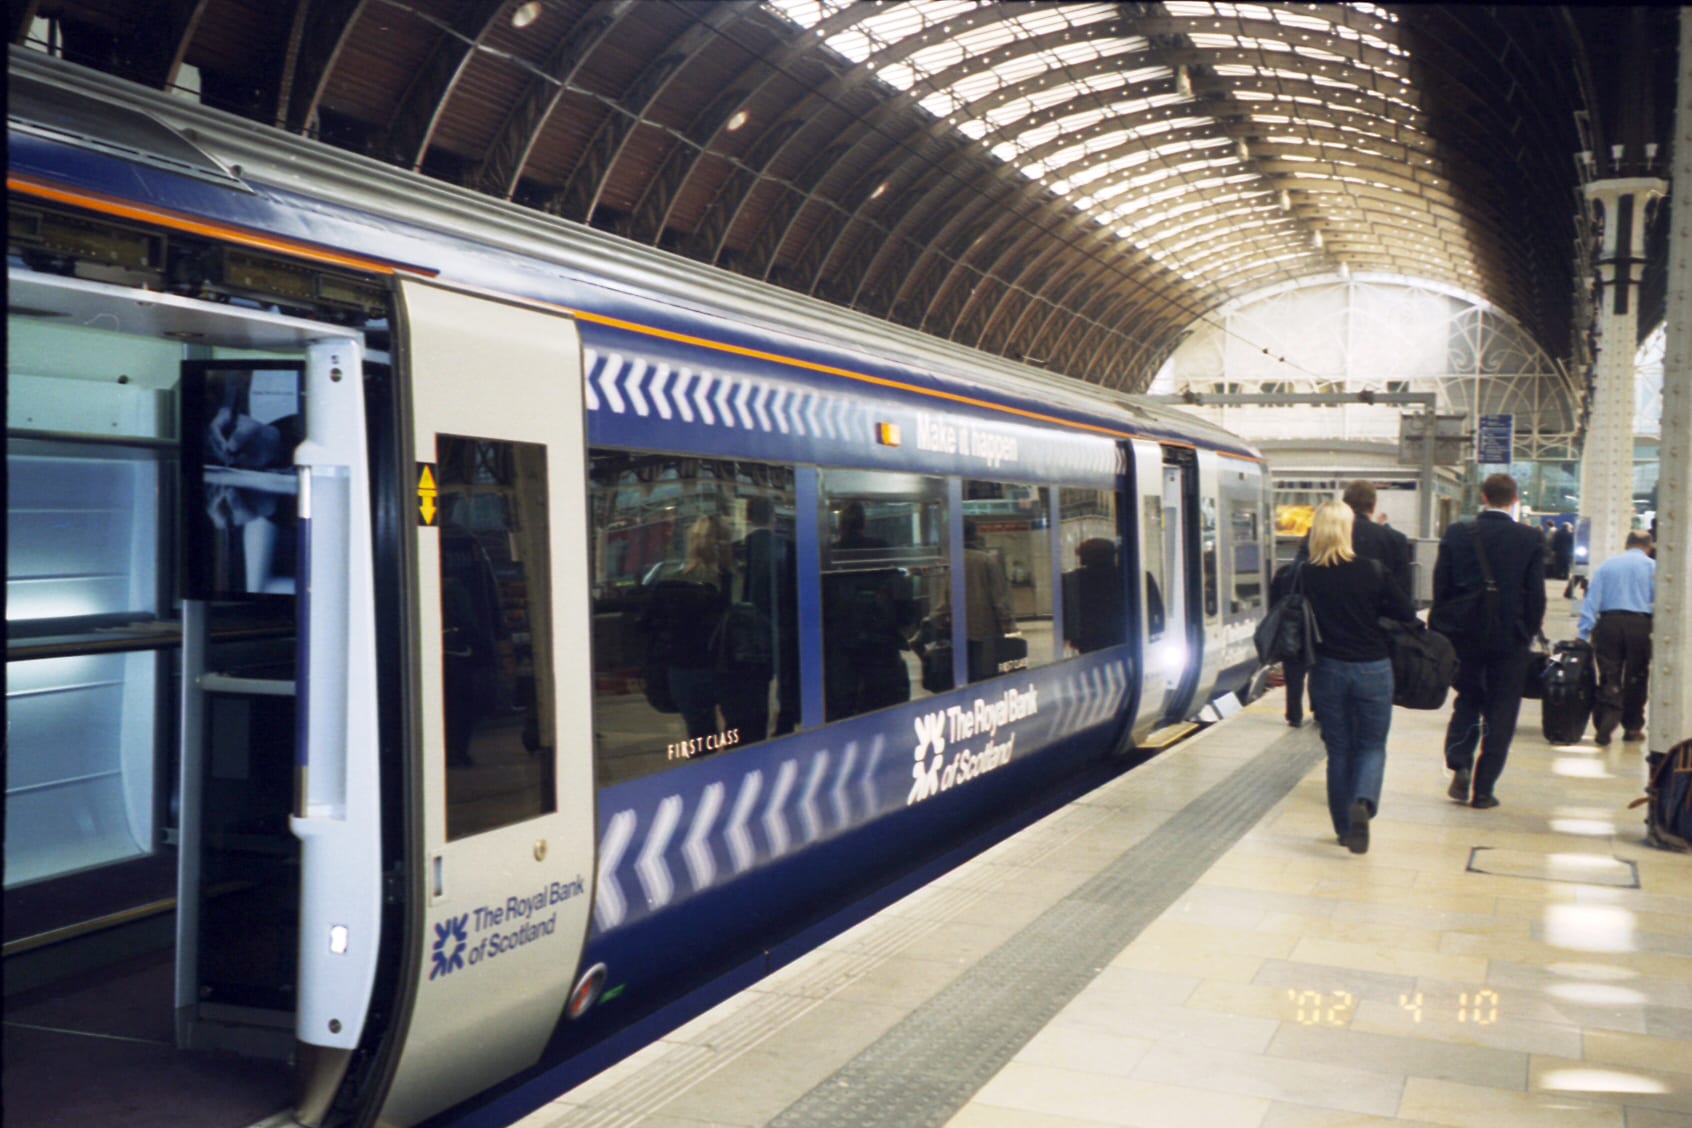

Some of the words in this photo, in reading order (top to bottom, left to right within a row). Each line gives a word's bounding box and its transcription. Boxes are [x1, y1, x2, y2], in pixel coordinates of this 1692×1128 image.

[917, 410, 957, 454] Make
[947, 706, 974, 744] The
[974, 690, 1008, 737] Royal
[1008, 683, 1038, 722] Bank
[667, 736, 703, 760] FIRST
[706, 728, 740, 750] CLASS
[940, 753, 961, 792] of
[956, 732, 1016, 785] Scotland
[473, 906, 503, 932] The
[505, 885, 548, 921] Royal
[550, 874, 584, 905] Bank
[468, 937, 488, 965] of
[487, 912, 557, 958] Scotland
